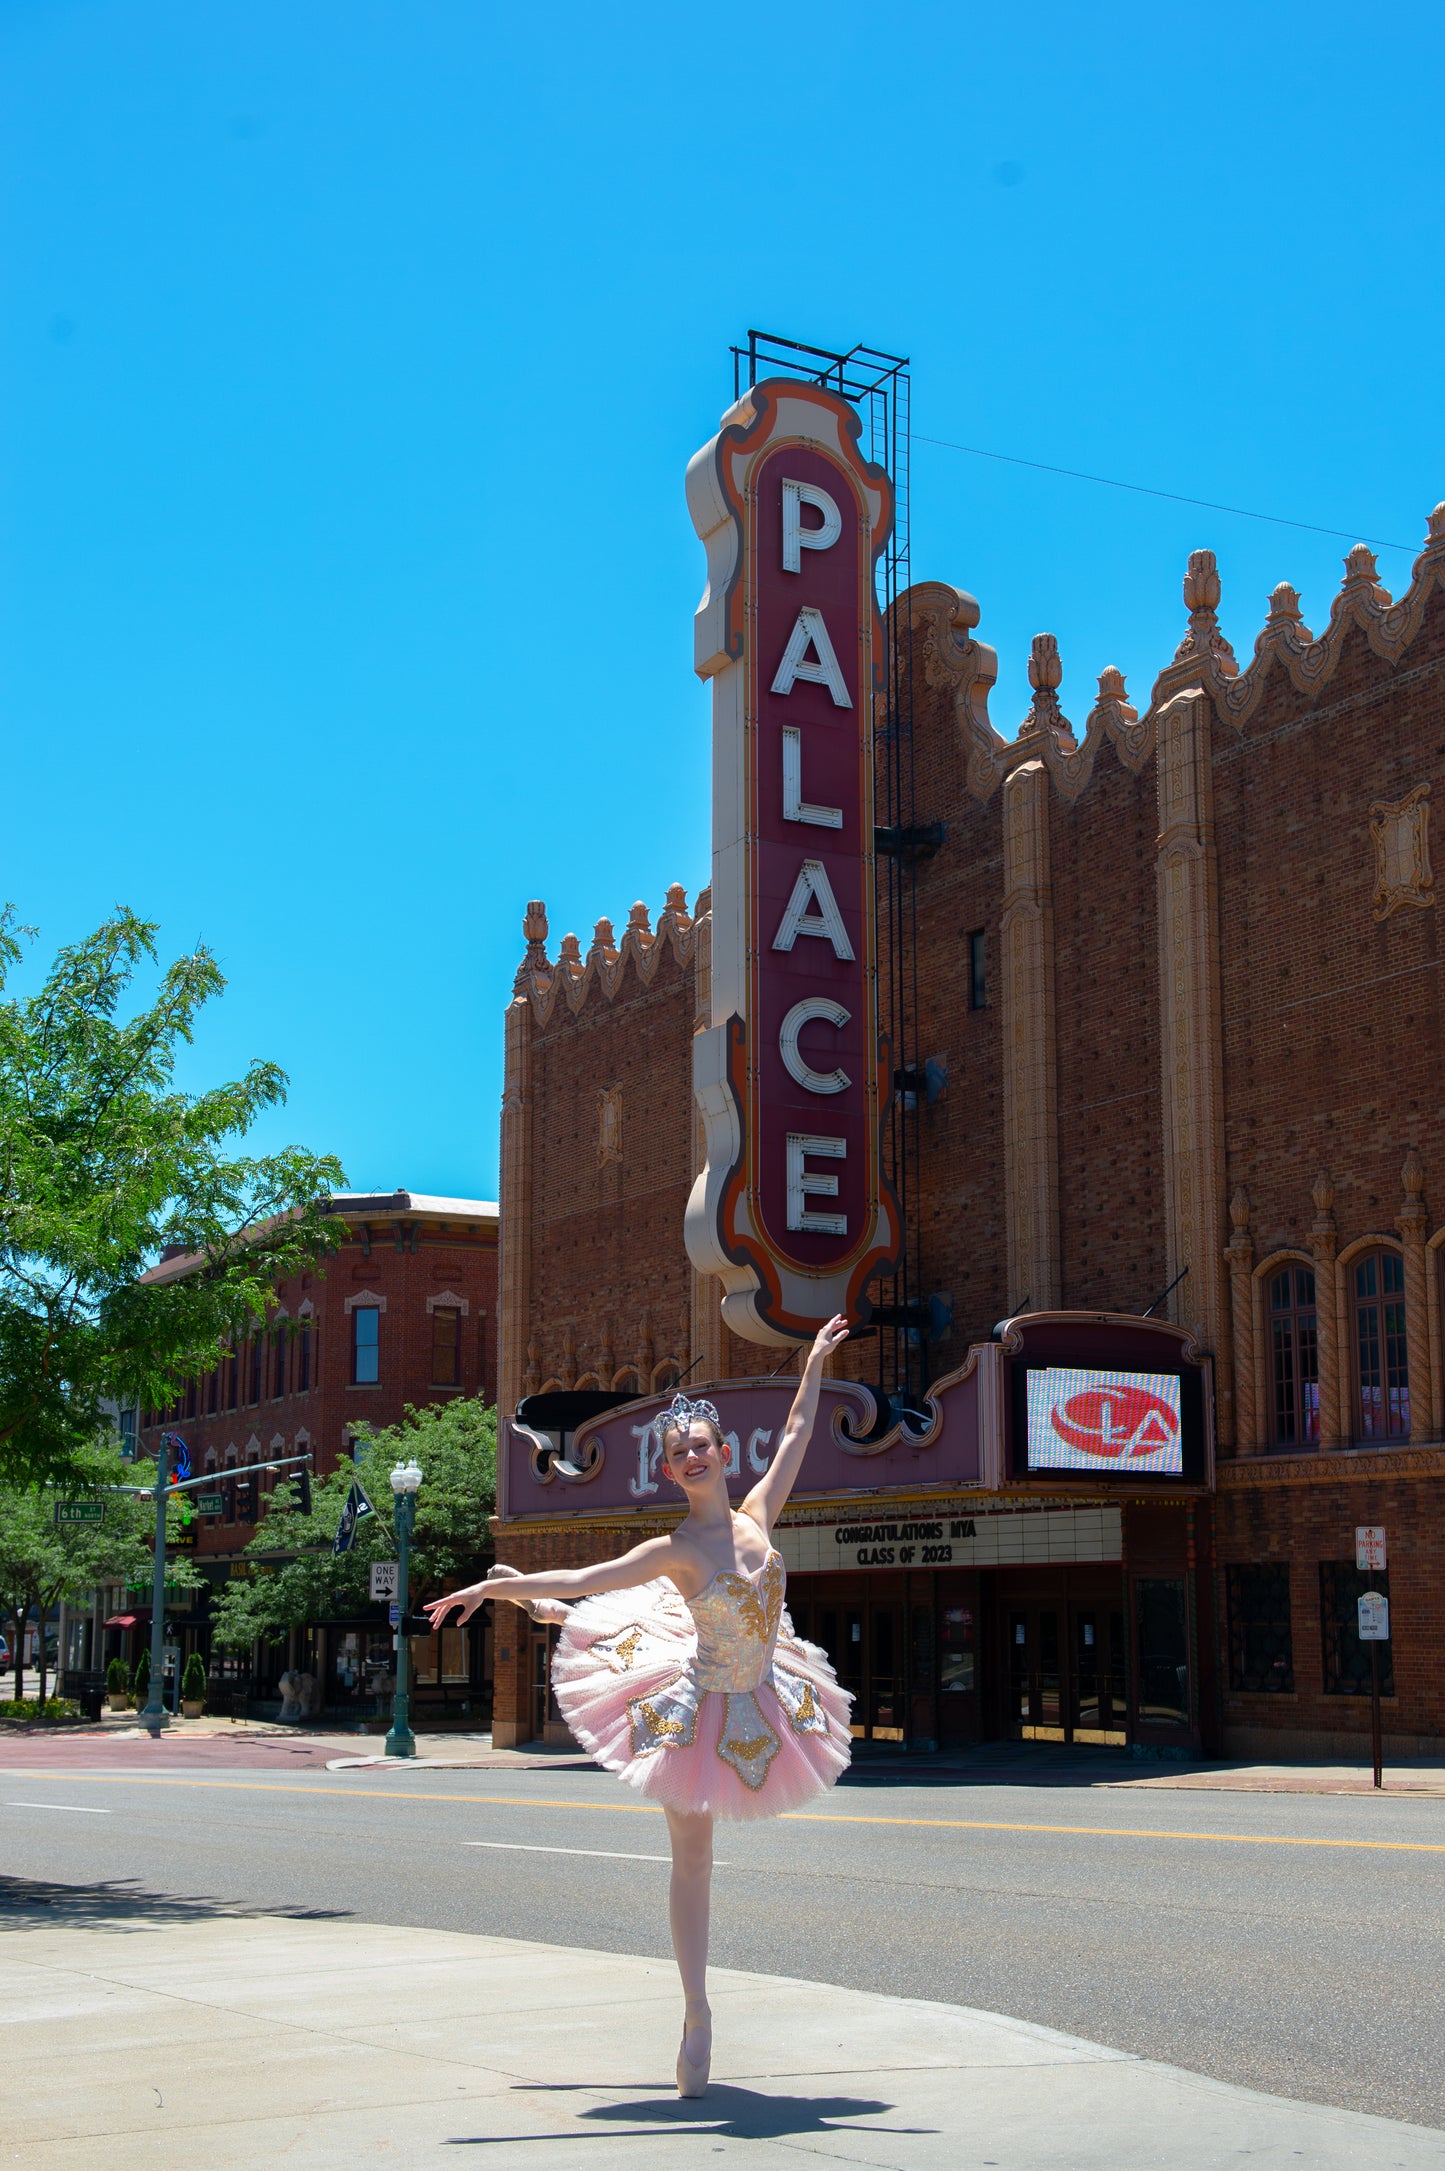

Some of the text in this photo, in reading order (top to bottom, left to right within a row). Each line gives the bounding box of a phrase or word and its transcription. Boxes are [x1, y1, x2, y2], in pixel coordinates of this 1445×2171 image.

[769, 476, 857, 1237] PALACE
[61, 1507, 82, 1519] 6th
[835, 1520, 976, 1544] CONGRATULATIONS MYA
[1365, 1531, 1376, 1539] NO
[1358, 1540, 1383, 1549] PARKING
[857, 1545, 952, 1565] CLASS OF 2023
[376, 1566, 395, 1575] ONE
[375, 1576, 395, 1585] WAY
